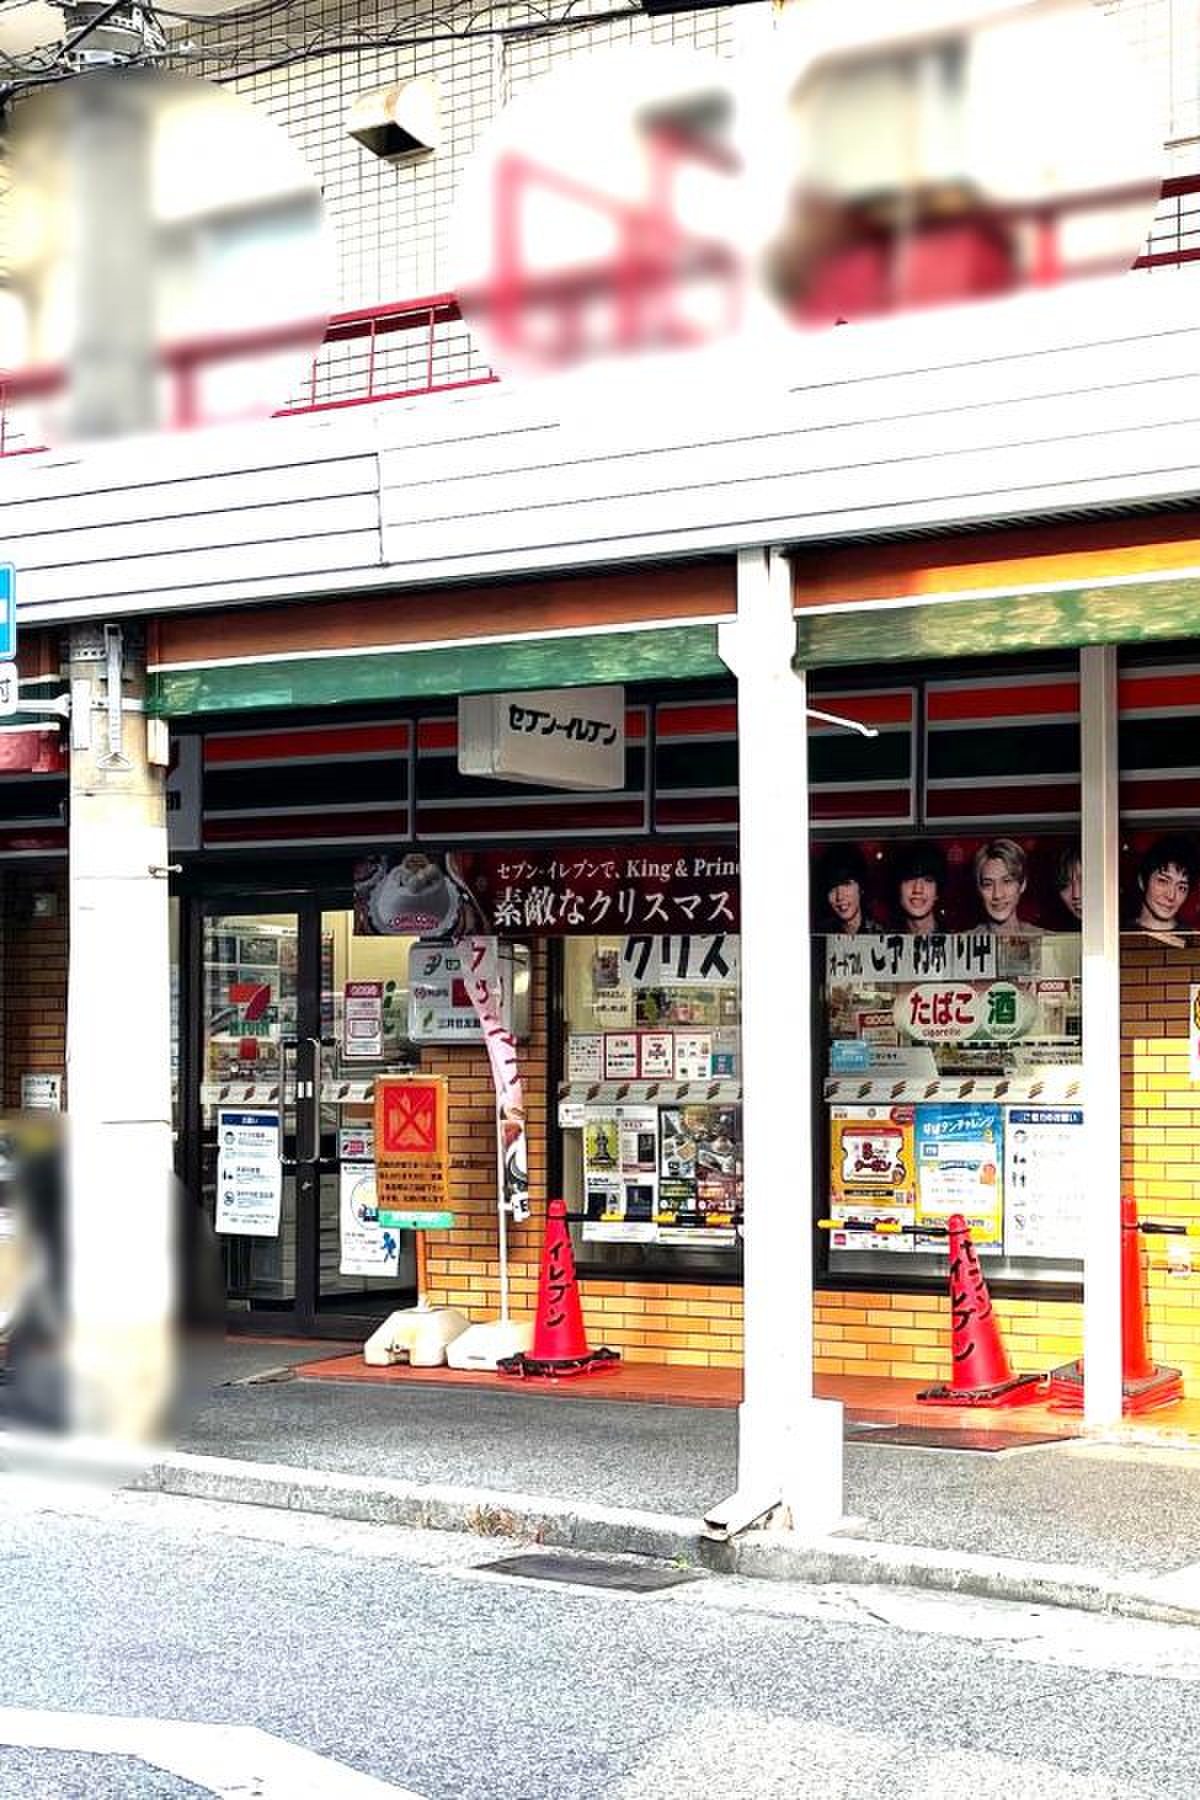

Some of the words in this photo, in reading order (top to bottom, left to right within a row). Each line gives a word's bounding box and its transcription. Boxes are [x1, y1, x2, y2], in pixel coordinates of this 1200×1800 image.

[626, 859, 672, 883] King
[674, 859, 688, 878] &
[693, 856, 740, 878] Prin
[494, 886, 735, 927] 素敵なクリスマス
[910, 991, 975, 1025] たばこ
[987, 991, 1016, 1024] 酒
[546, 1241, 572, 1327] イレブン
